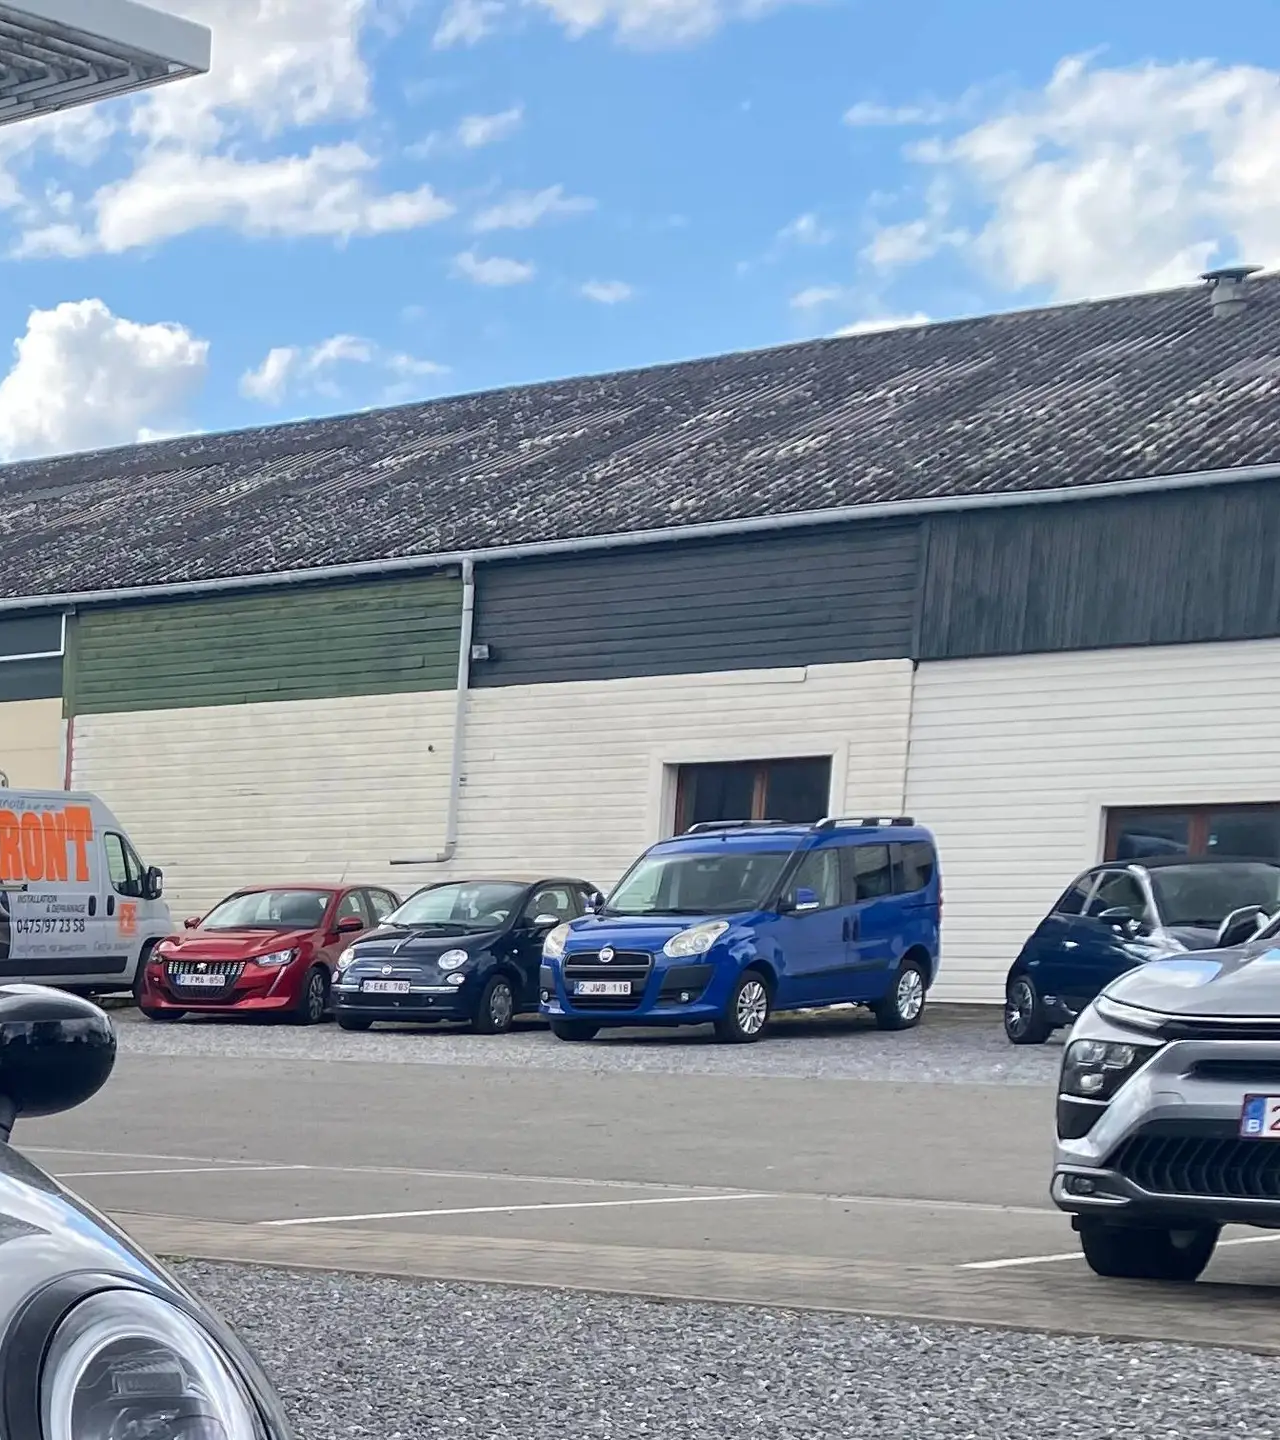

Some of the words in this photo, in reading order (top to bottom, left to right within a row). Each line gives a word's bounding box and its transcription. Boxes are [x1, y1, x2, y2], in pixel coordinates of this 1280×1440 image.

[59, 919, 71, 933] 23
[73, 919, 85, 933] 58
[1246, 1118, 1261, 1133] B
